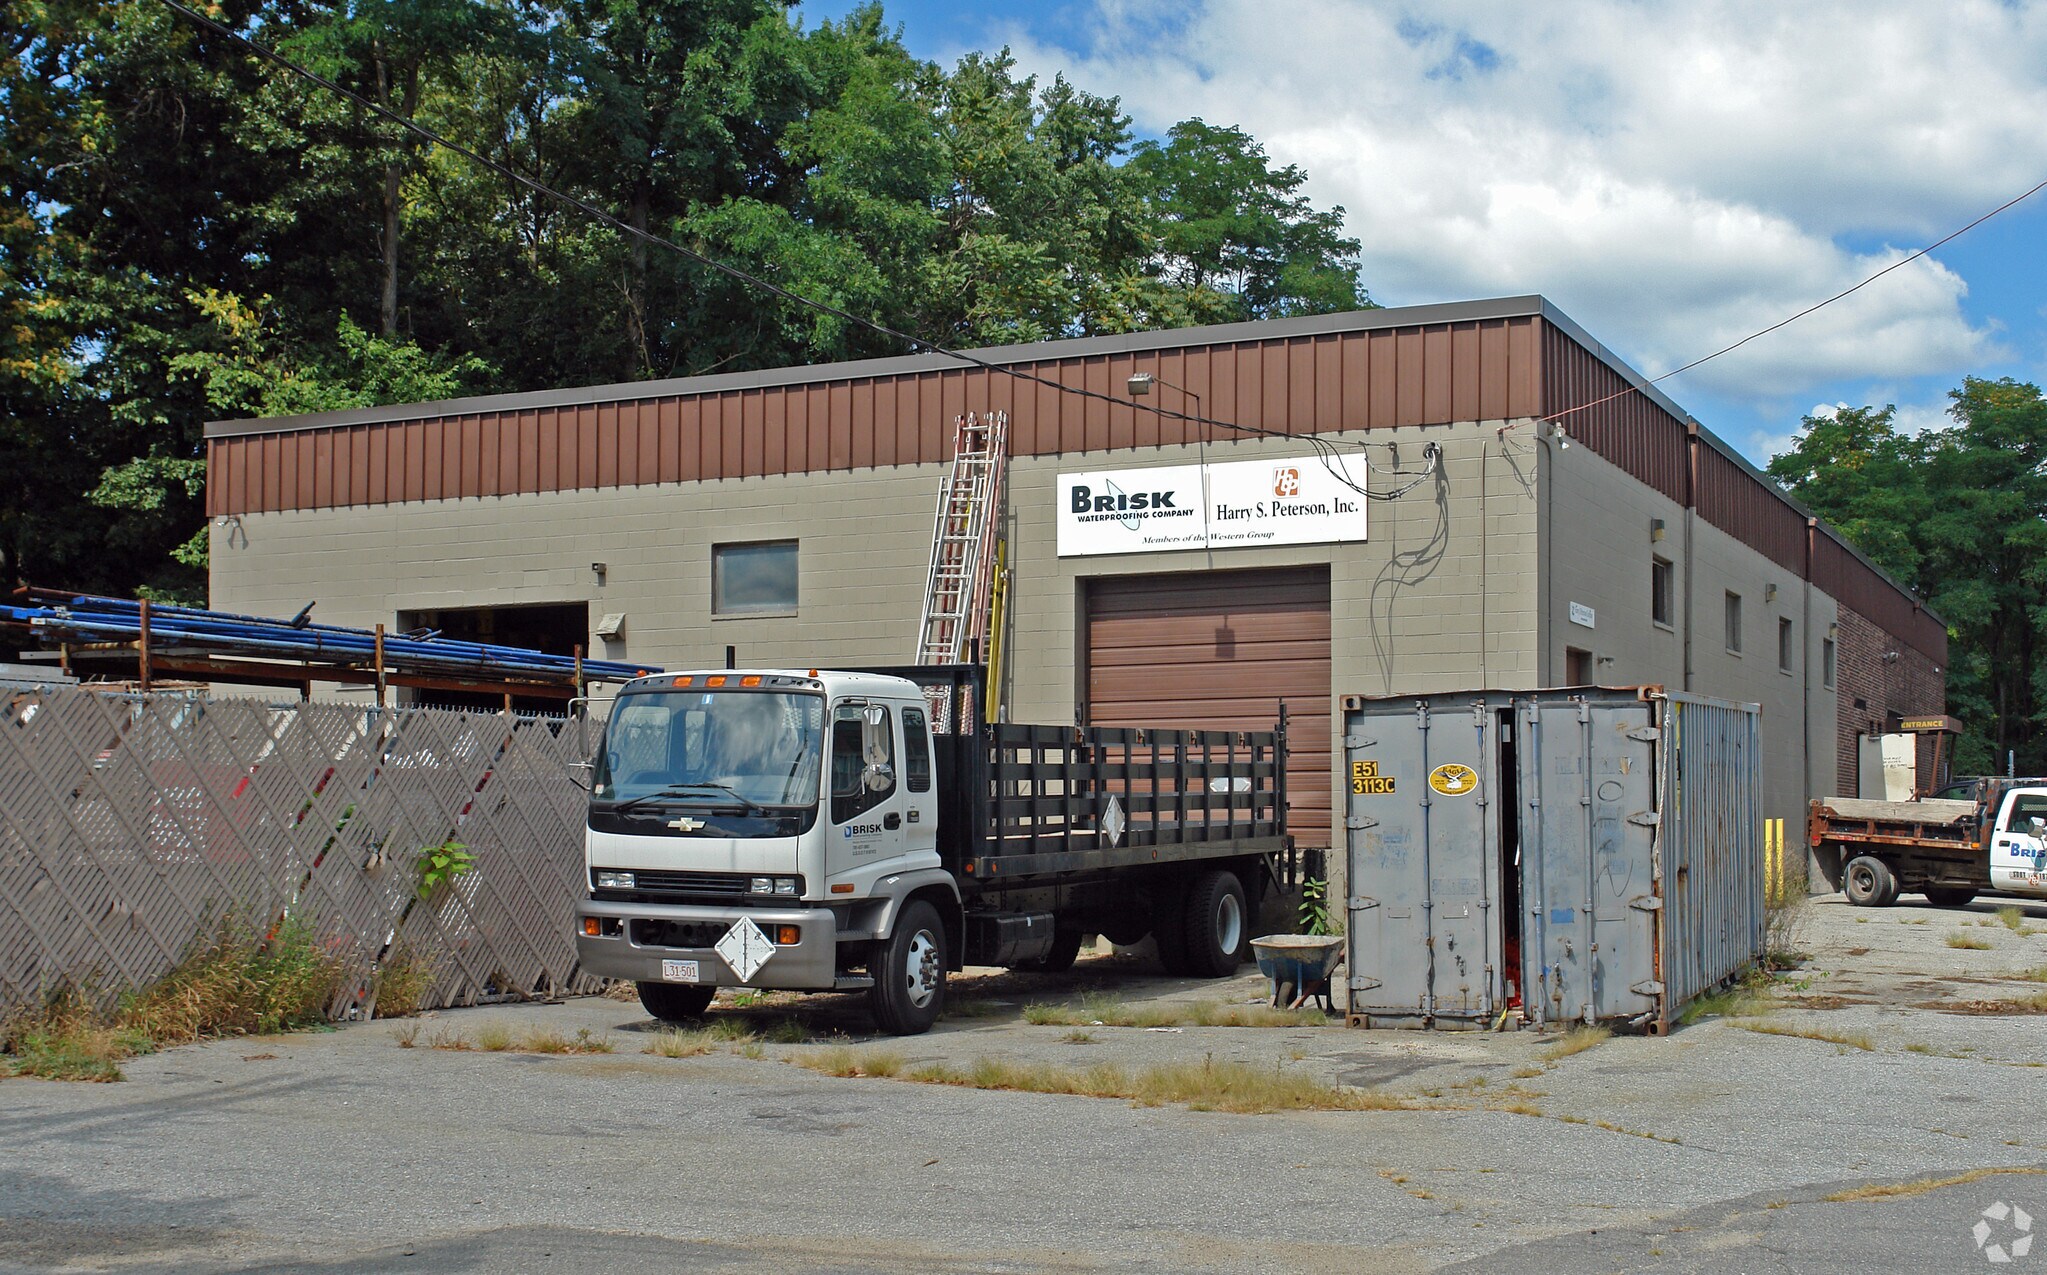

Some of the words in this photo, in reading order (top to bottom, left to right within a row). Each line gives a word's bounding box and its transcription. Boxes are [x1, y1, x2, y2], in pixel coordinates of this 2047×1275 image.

[1072, 486, 1175, 513] BRISK
[1078, 511, 1149, 522] WATERPROOFING
[1152, 509, 1195, 518] COMPANY
[1217, 503, 1252, 522] Harry
[1256, 501, 1268, 518] S.
[1272, 500, 1330, 517] Peterson,
[1334, 497, 1359, 514] Inc.
[1142, 536, 1180, 544] Members
[1183, 534, 1193, 543] of
[1194, 533, 1207, 541] the
[1210, 532, 1245, 540] Western
[1247, 531, 1275, 540] Group
[1901, 720, 1943, 729] ENTRANCE
[1353, 762, 1377, 776] E51
[1442, 766, 1466, 775] EAGLE
[1353, 779, 1394, 793] 3113C
[853, 824, 881, 834] BRISK
[2011, 843, 2047, 857] BRIS
